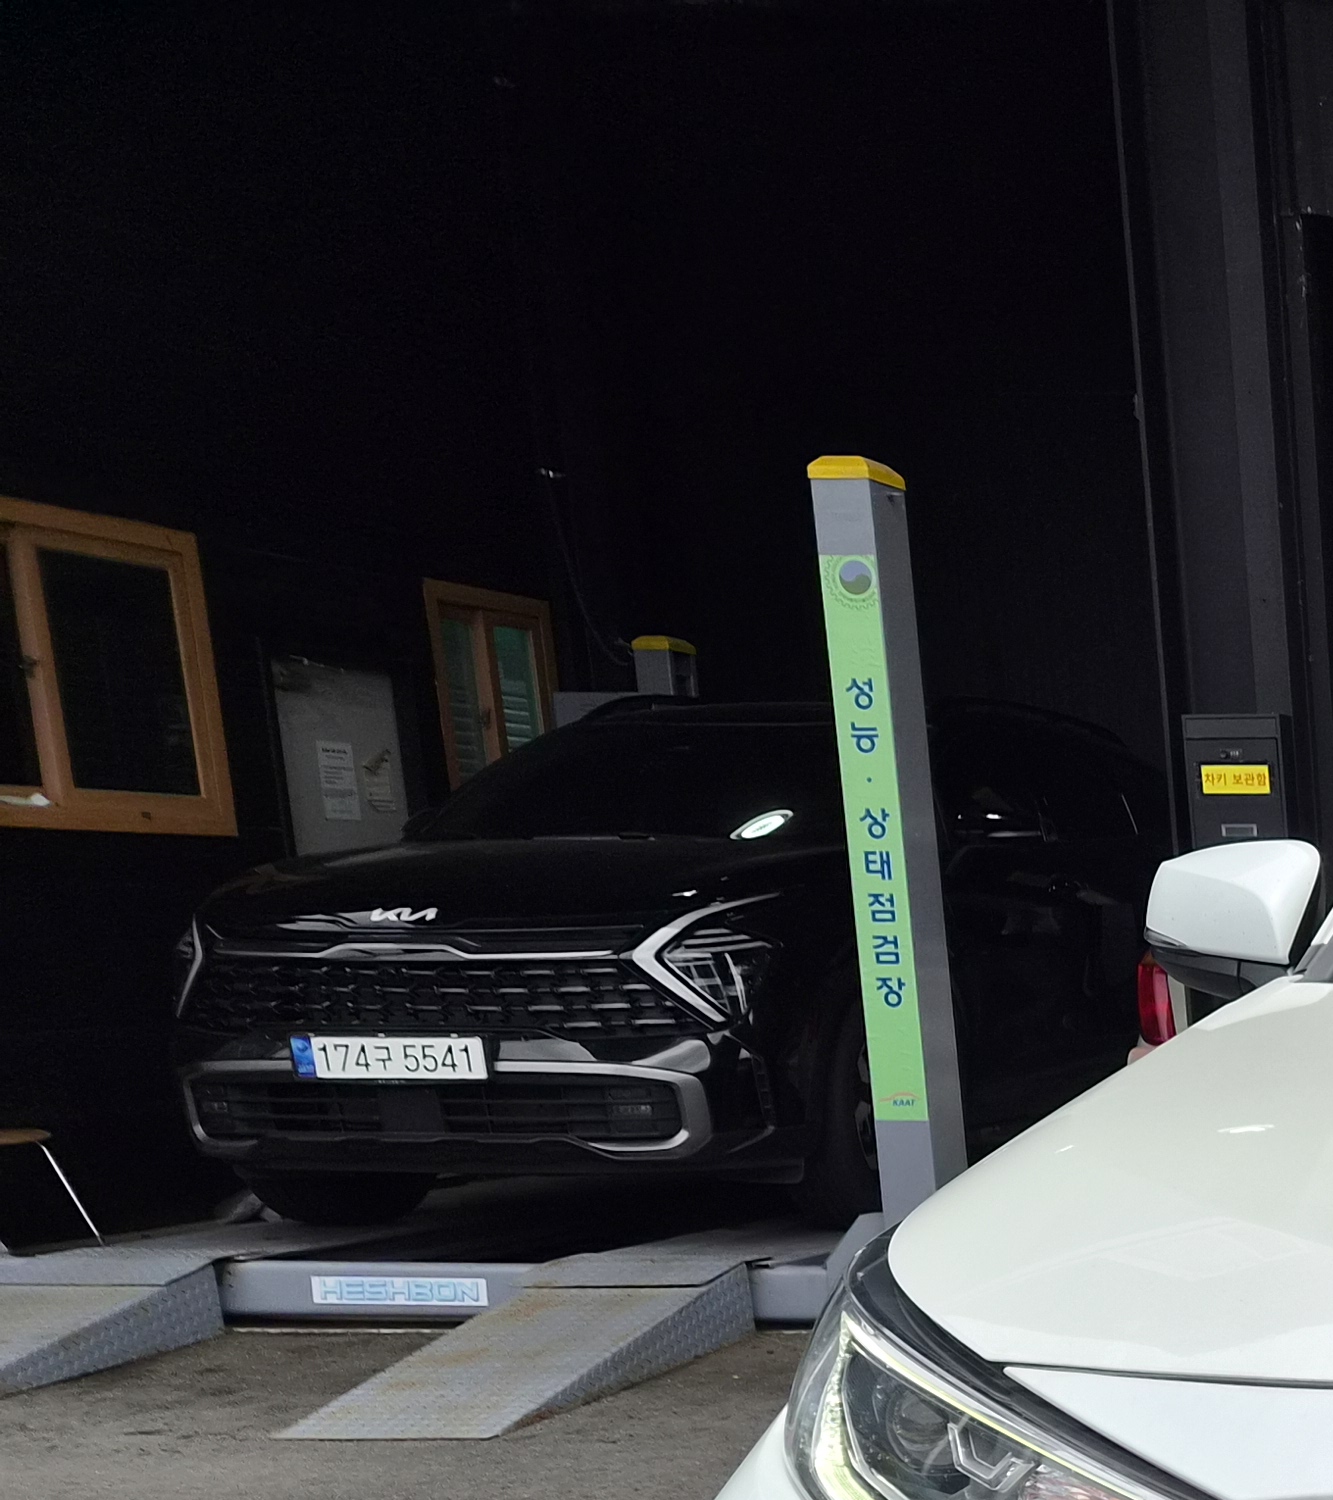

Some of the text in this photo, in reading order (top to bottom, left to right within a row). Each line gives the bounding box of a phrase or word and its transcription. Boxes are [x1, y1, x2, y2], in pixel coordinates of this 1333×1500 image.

[1204, 773, 1267, 787] 차키 보관함
[317, 1043, 474, 1073] 174구 5541
[320, 1279, 480, 1303] HESHBON
